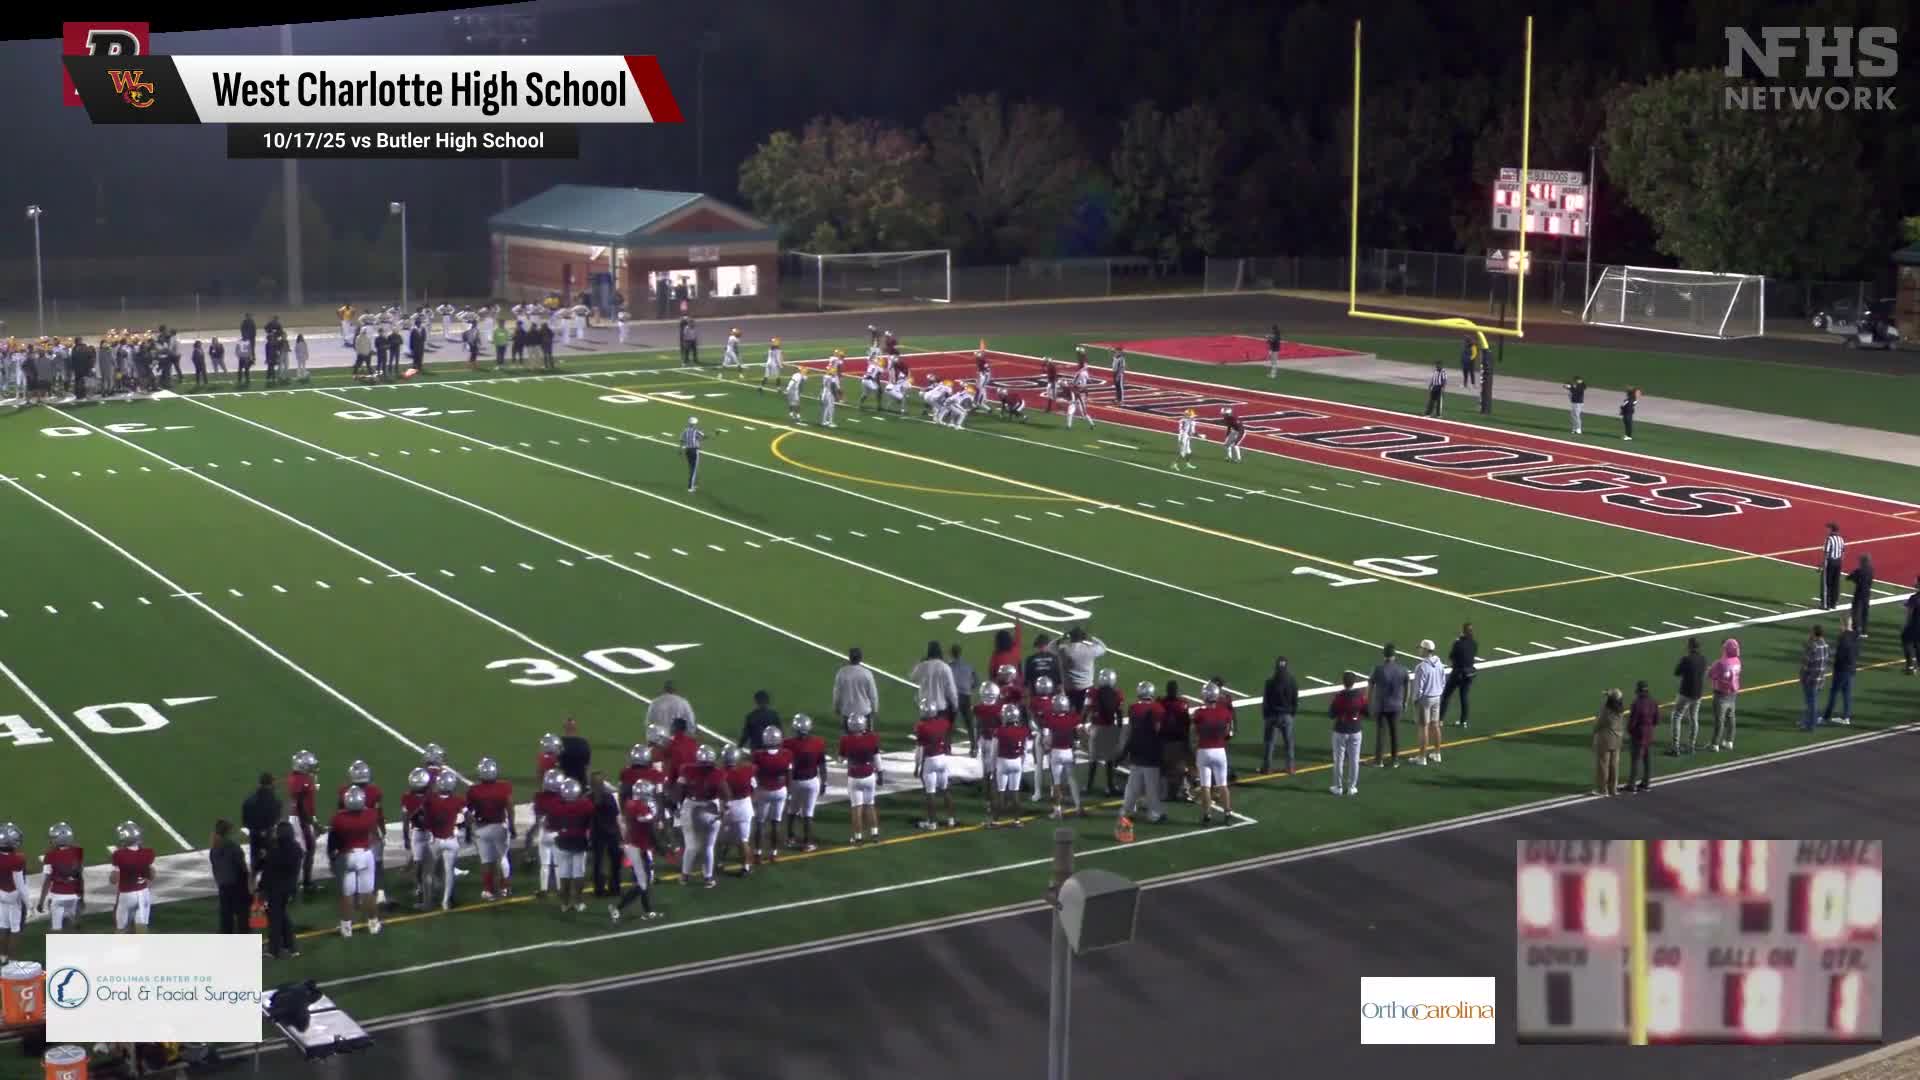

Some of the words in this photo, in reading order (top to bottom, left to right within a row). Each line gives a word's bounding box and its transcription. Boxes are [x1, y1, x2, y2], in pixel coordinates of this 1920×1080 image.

[1291, 554, 1439, 588] 10
[920, 599, 1093, 634] 20
[485, 646, 675, 686] 30
